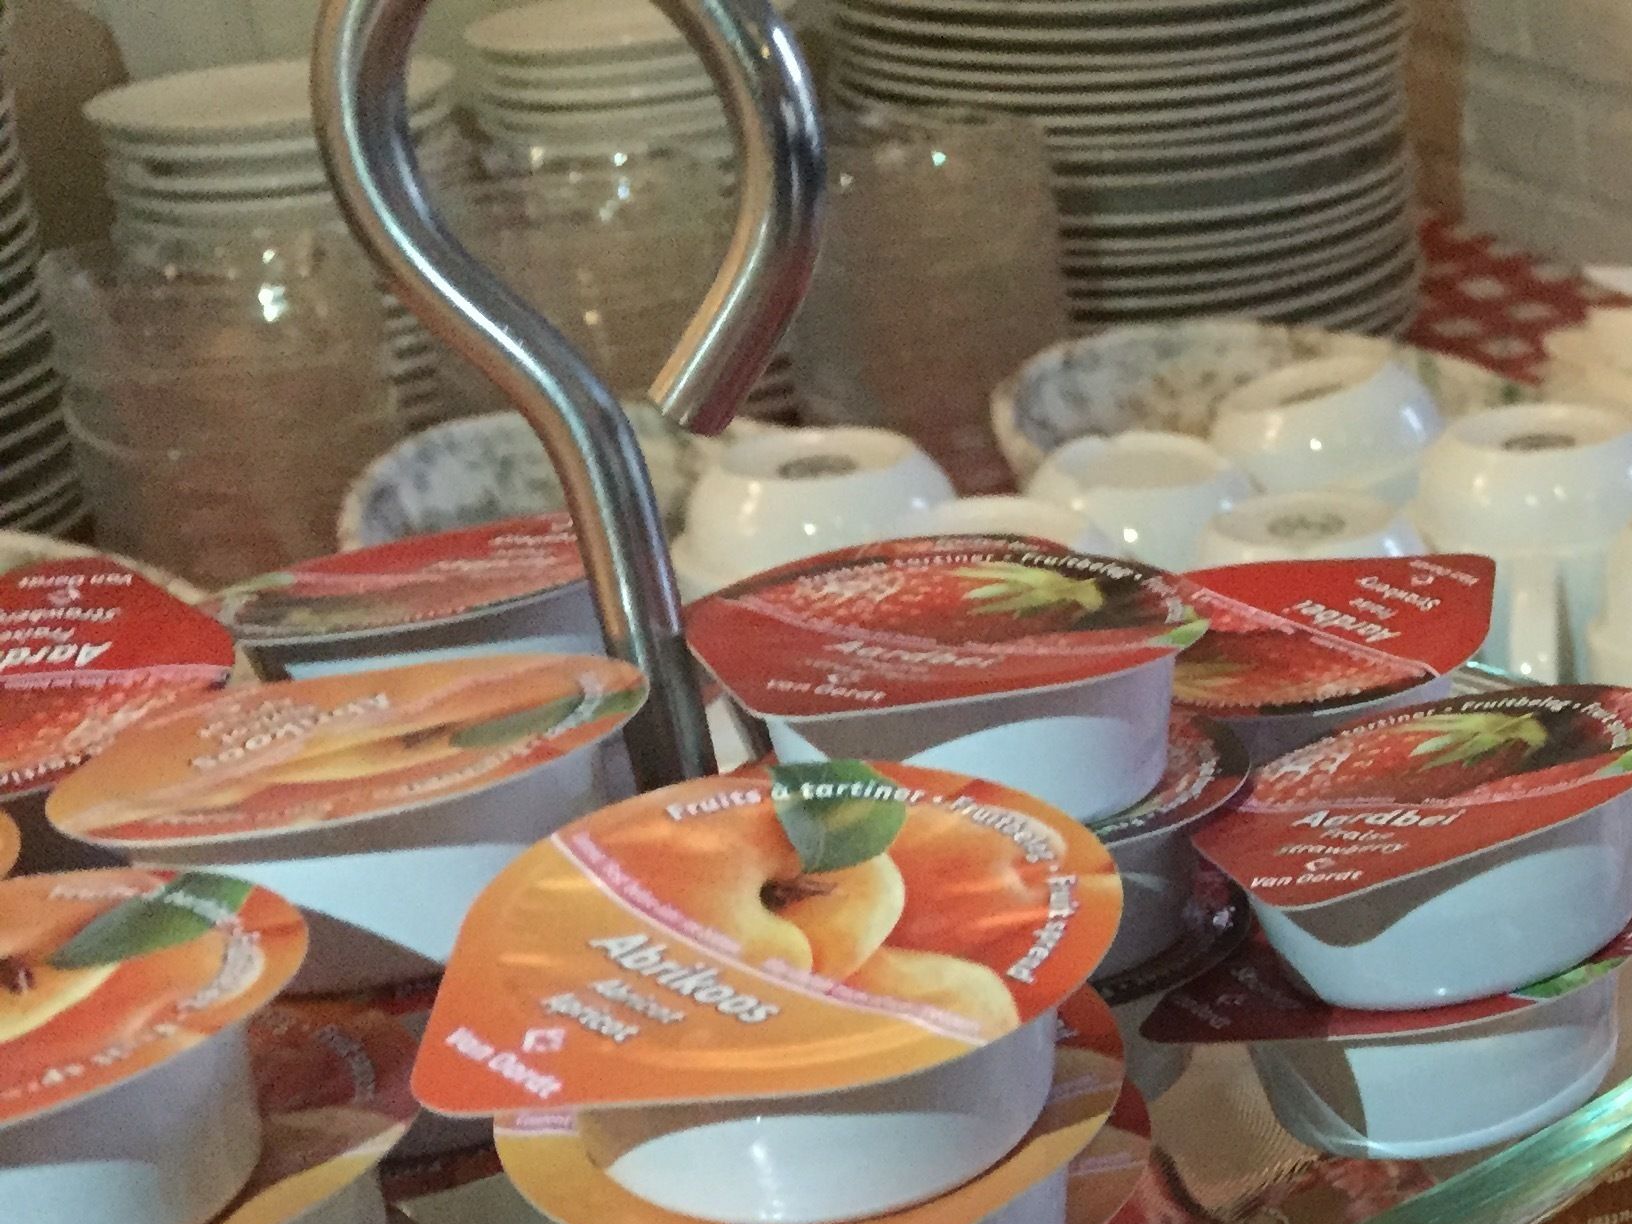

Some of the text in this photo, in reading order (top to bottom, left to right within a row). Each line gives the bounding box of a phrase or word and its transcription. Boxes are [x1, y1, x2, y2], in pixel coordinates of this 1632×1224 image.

[666, 788, 763, 823] Fruits
[800, 780, 926, 803] tartiner
[1291, 808, 1467, 829] Aardbei
[587, 933, 781, 1024] Abrikoos
